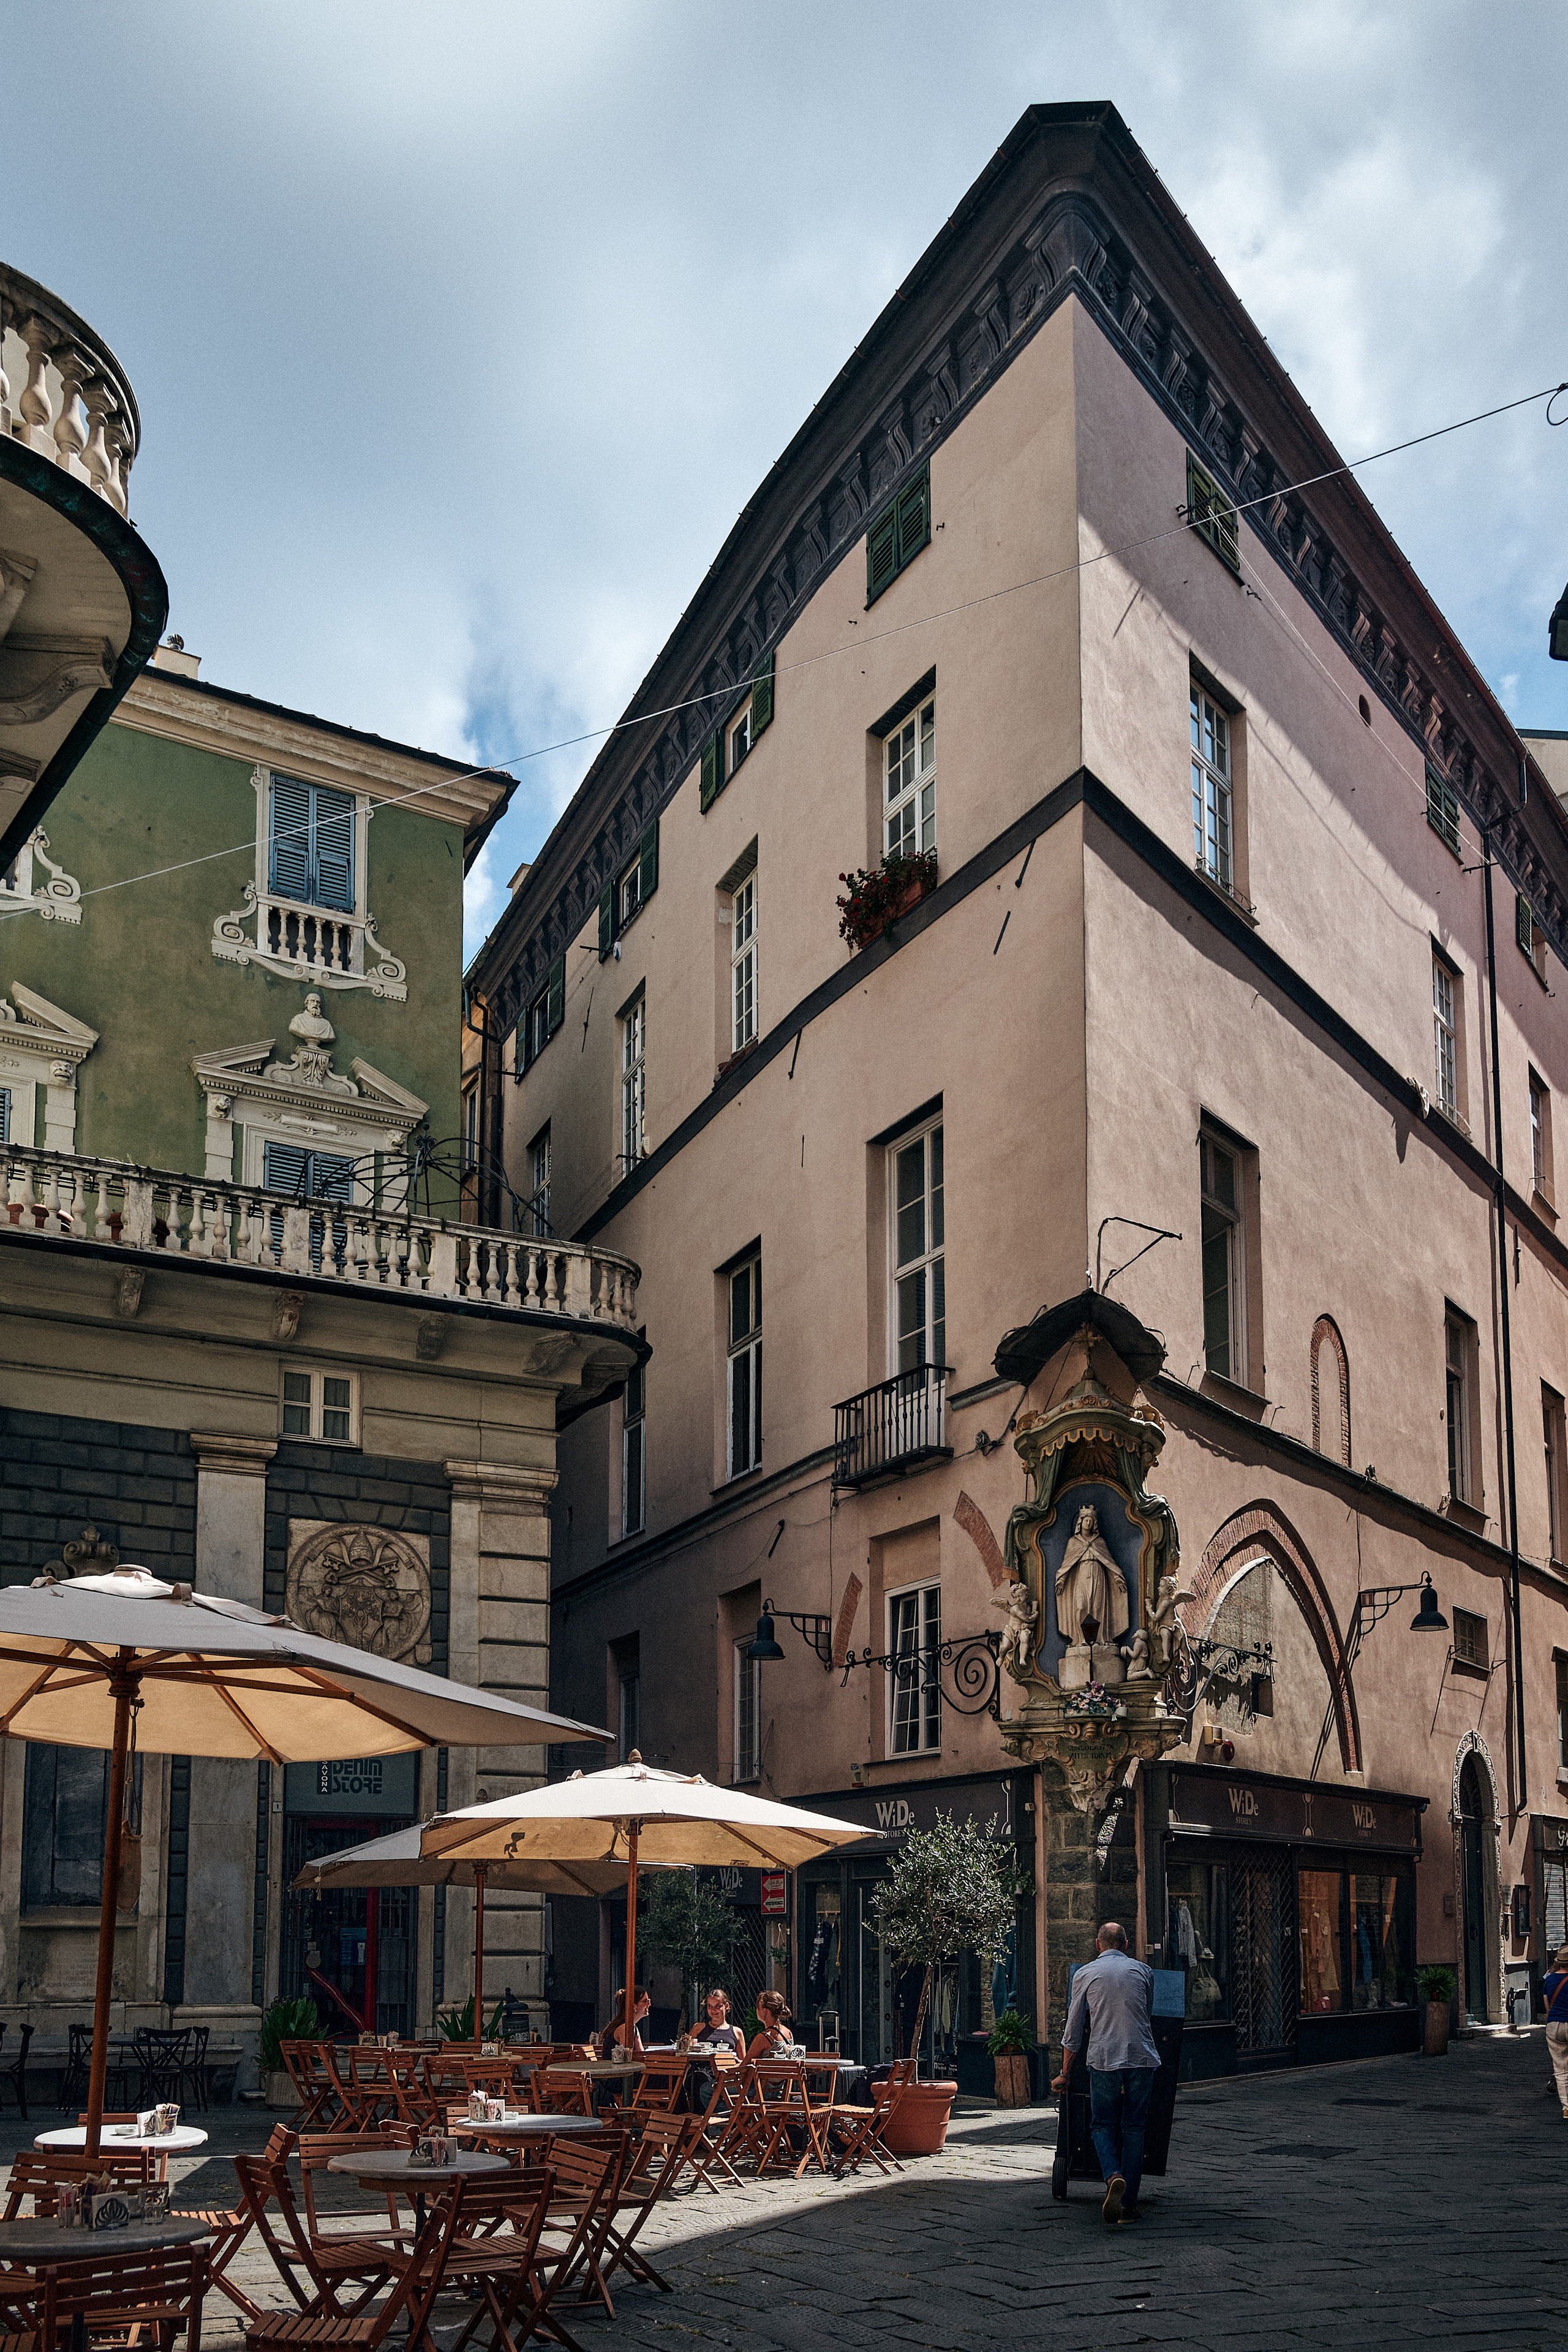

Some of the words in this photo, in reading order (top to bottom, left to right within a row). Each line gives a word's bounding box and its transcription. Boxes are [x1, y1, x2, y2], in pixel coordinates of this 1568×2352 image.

[332, 1759, 383, 1776] DENIM
[320, 1760, 329, 1793] SAVONA
[332, 1776, 383, 1794] STORE
[887, 1830, 906, 1838] TORES
